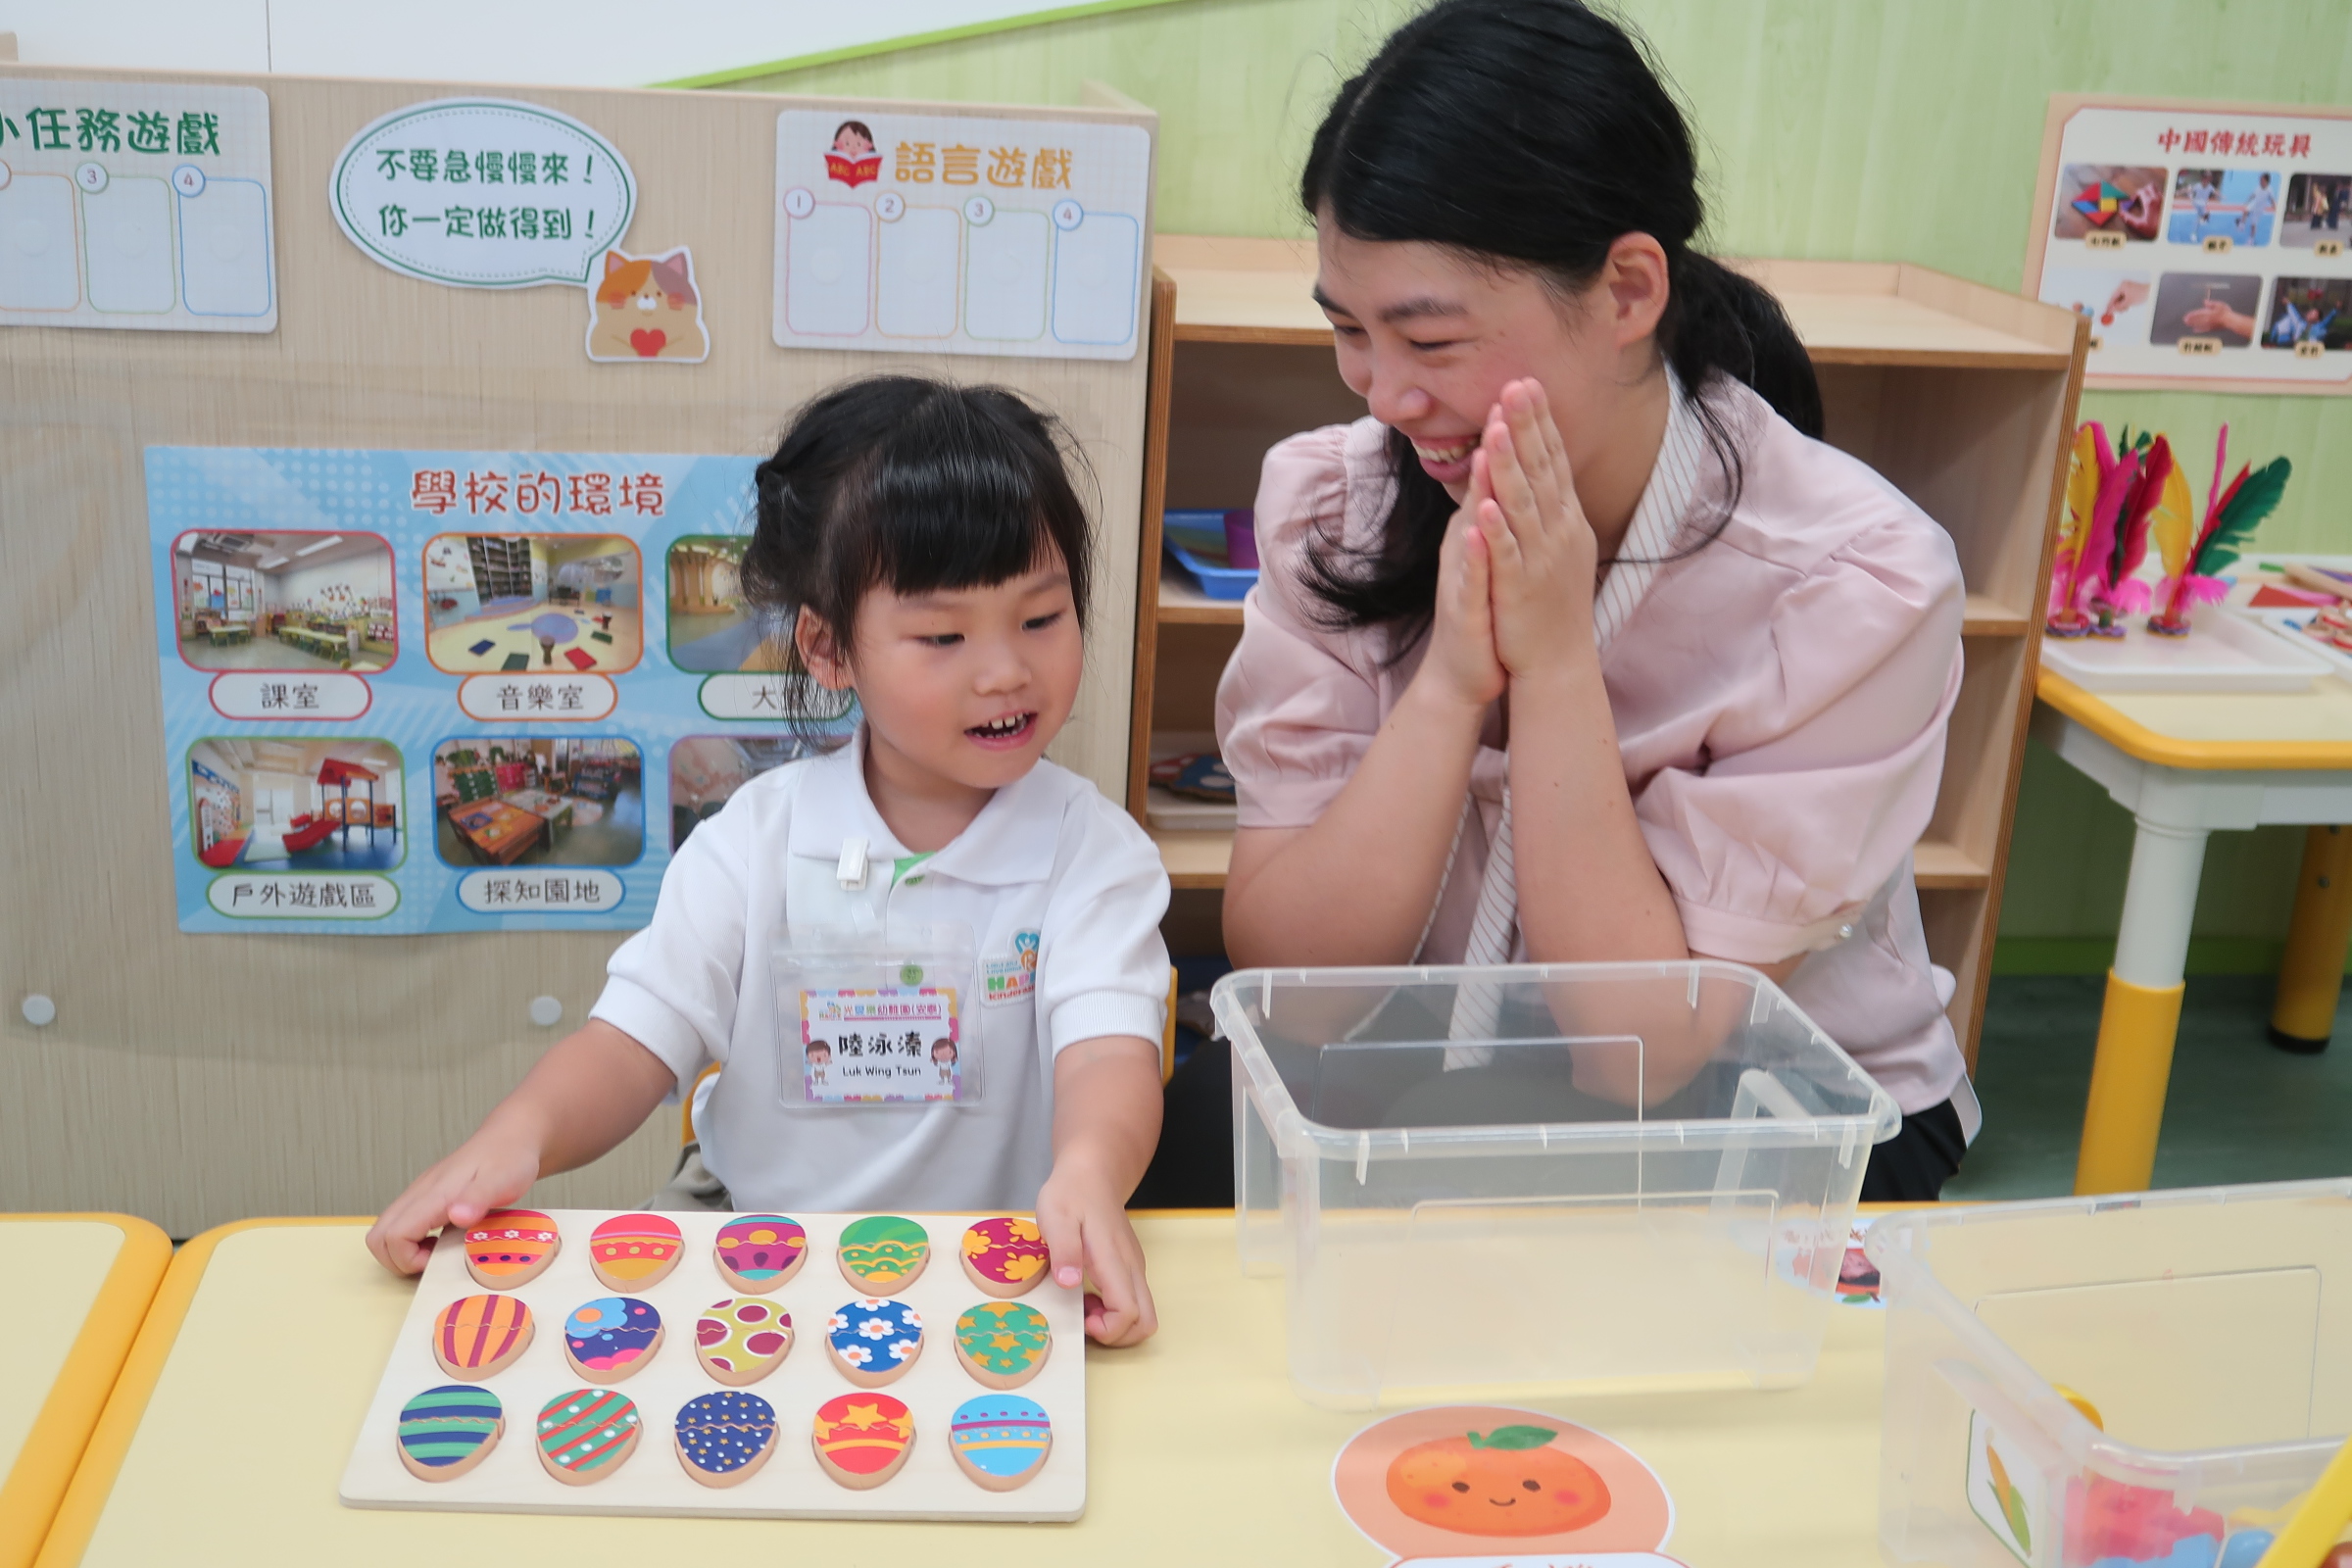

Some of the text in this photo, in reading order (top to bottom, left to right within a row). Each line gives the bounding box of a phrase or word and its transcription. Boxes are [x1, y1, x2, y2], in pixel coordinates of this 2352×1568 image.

[2158, 127, 2312, 159] 中國傳統玩具
[86, 169, 194, 187] 3 4
[895, 141, 1073, 189] 語言遊戲
[885, 199, 895, 214] 2
[974, 203, 984, 218] 3
[1062, 208, 1073, 221] 4
[412, 470, 663, 515] 學校的環境
[260, 682, 319, 710] 課室
[497, 683, 584, 711] 音樂室
[484, 878, 601, 905] 探知園地
[843, 1066, 921, 1079] Luk Wing Tsun
